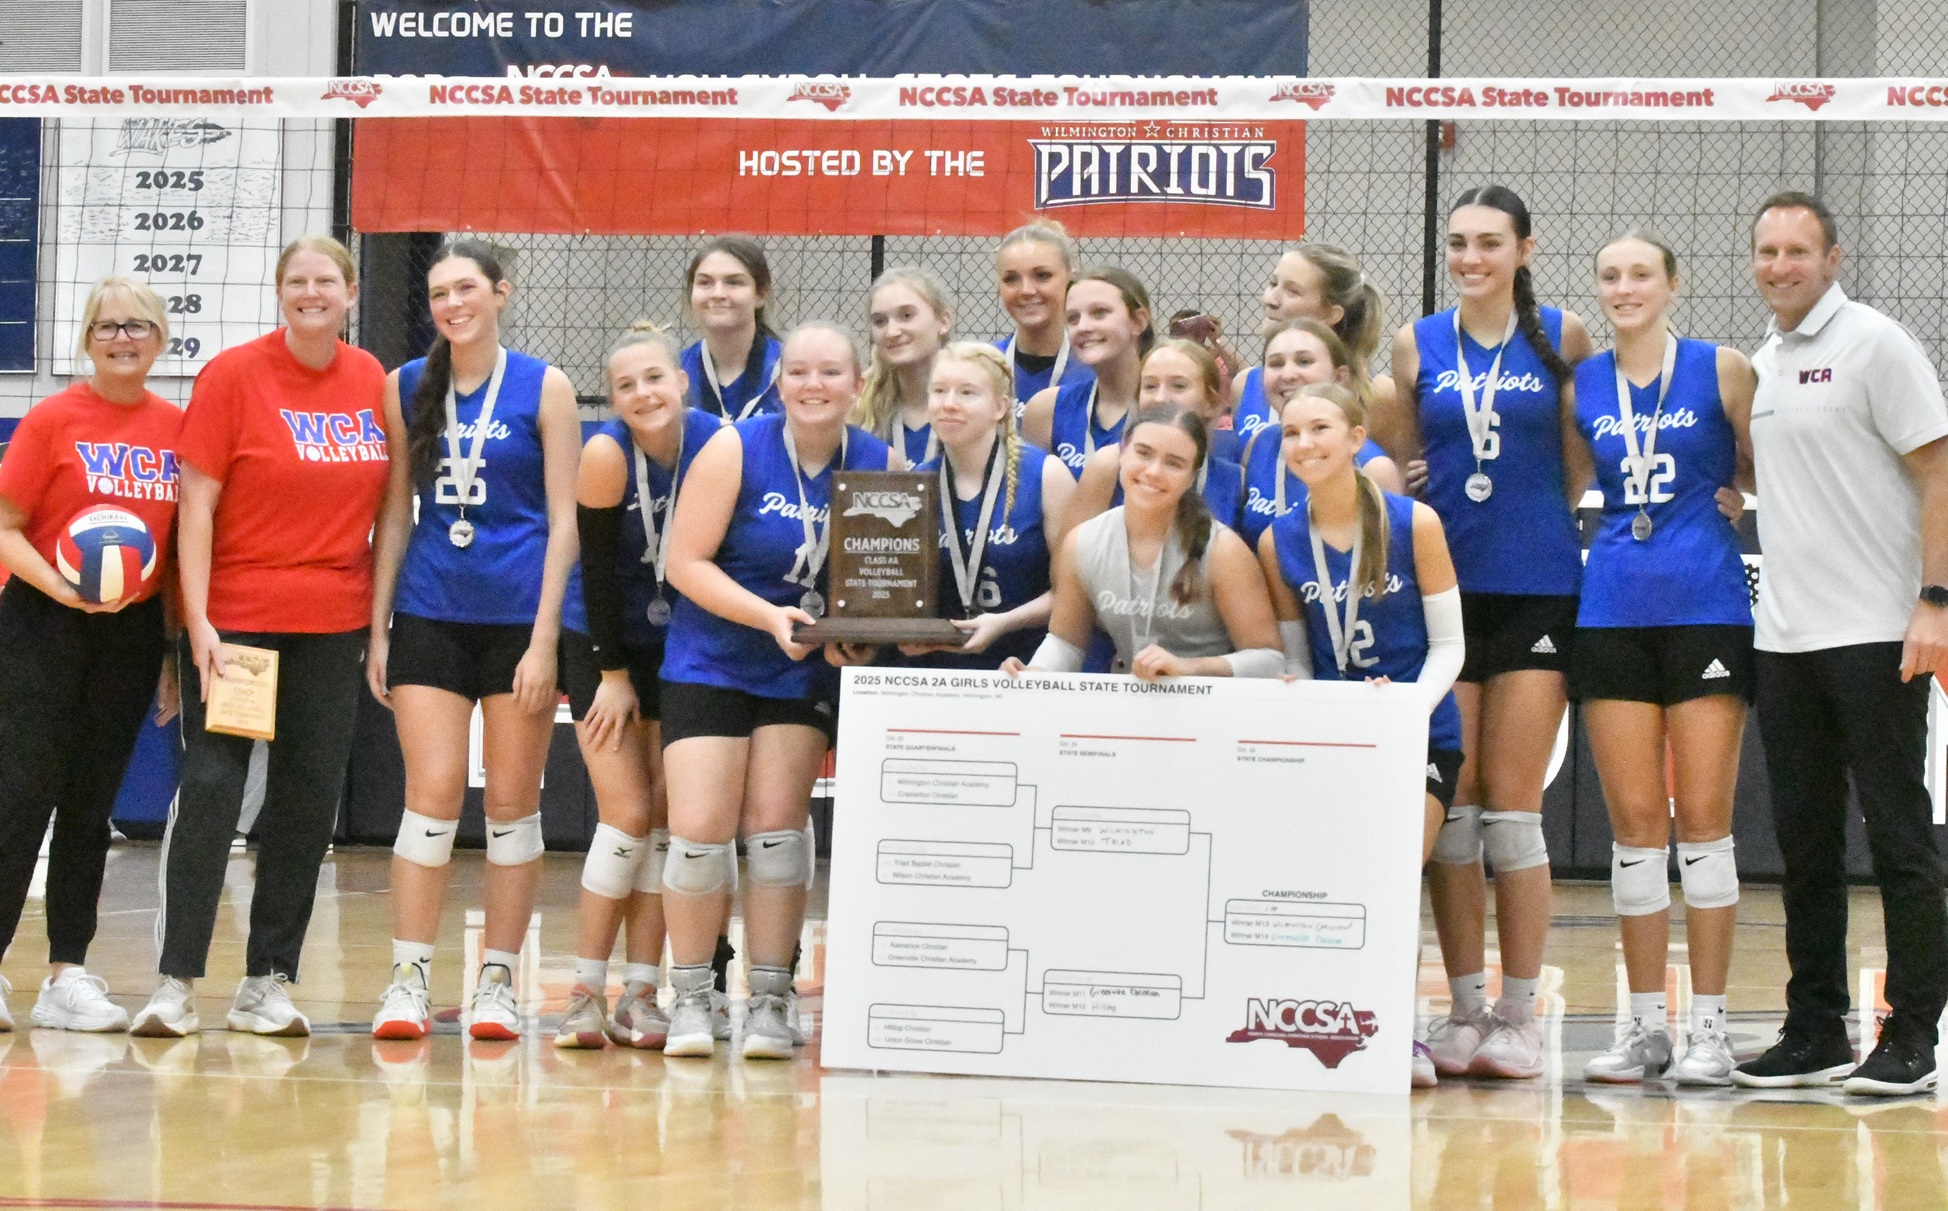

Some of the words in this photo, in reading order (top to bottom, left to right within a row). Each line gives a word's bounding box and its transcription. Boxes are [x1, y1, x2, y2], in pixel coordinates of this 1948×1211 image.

[372, 12, 513, 38] WELCOME
[525, 12, 564, 38] TO
[575, 12, 633, 38] THE
[0, 84, 60, 104] CCSA
[64, 84, 125, 104] State
[129, 84, 273, 105] Tournament
[328, 80, 374, 95] NCCSA
[429, 85, 514, 105] NCCSA
[519, 85, 581, 105] State
[587, 85, 738, 106] Tournament
[794, 81, 845, 97] NCCSA
[899, 86, 986, 107] NCCSA
[993, 86, 1057, 107] State
[1063, 86, 1218, 108] Tournament
[1277, 81, 1329, 96] NCCSA
[1386, 86, 1472, 107] NCCSA
[1482, 86, 1548, 107] State
[1554, 87, 1715, 107] Tournament
[1774, 81, 1827, 96] NCCSA
[1041, 126, 1137, 138] WILMINGTON
[1167, 127, 1265, 138] CHRISTIAN
[739, 150, 860, 176] HOSTED
[872, 150, 913, 176] BY
[925, 150, 985, 177] THE
[135, 170, 204, 191] 2025
[1035, 143, 1273, 206] PATRIOTS
[134, 210, 204, 231] 2026
[133, 253, 203, 275] 2027
[168, 294, 202, 314] 28
[168, 337, 201, 358] 29
[1799, 368, 1832, 384] WCA
[279, 408, 386, 446] WCA
[75, 441, 180, 484] WCA
[1620, 453, 1676, 504] 22
[853, 493, 912, 508] NCCSA
[844, 537, 920, 552] CHAMPIONS
[864, 557, 887, 565] CLASS
[859, 567, 904, 577] VOLLEYBALL
[845, 580, 866, 588] STATE
[868, 580, 917, 589] TOURNAMENT
[853, 675, 882, 685] 2025
[885, 675, 929, 687] NCCSA
[932, 677, 947, 687] 2A
[951, 678, 989, 689] GIRLS
[993, 679, 1076, 692] VOLLEYBALL
[1080, 681, 1119, 693] STATE
[1123, 683, 1213, 695] TOURNAMENT
[1262, 889, 1328, 899] CHAMPIONSHIP
[1246, 997, 1361, 1035] NCCSA
